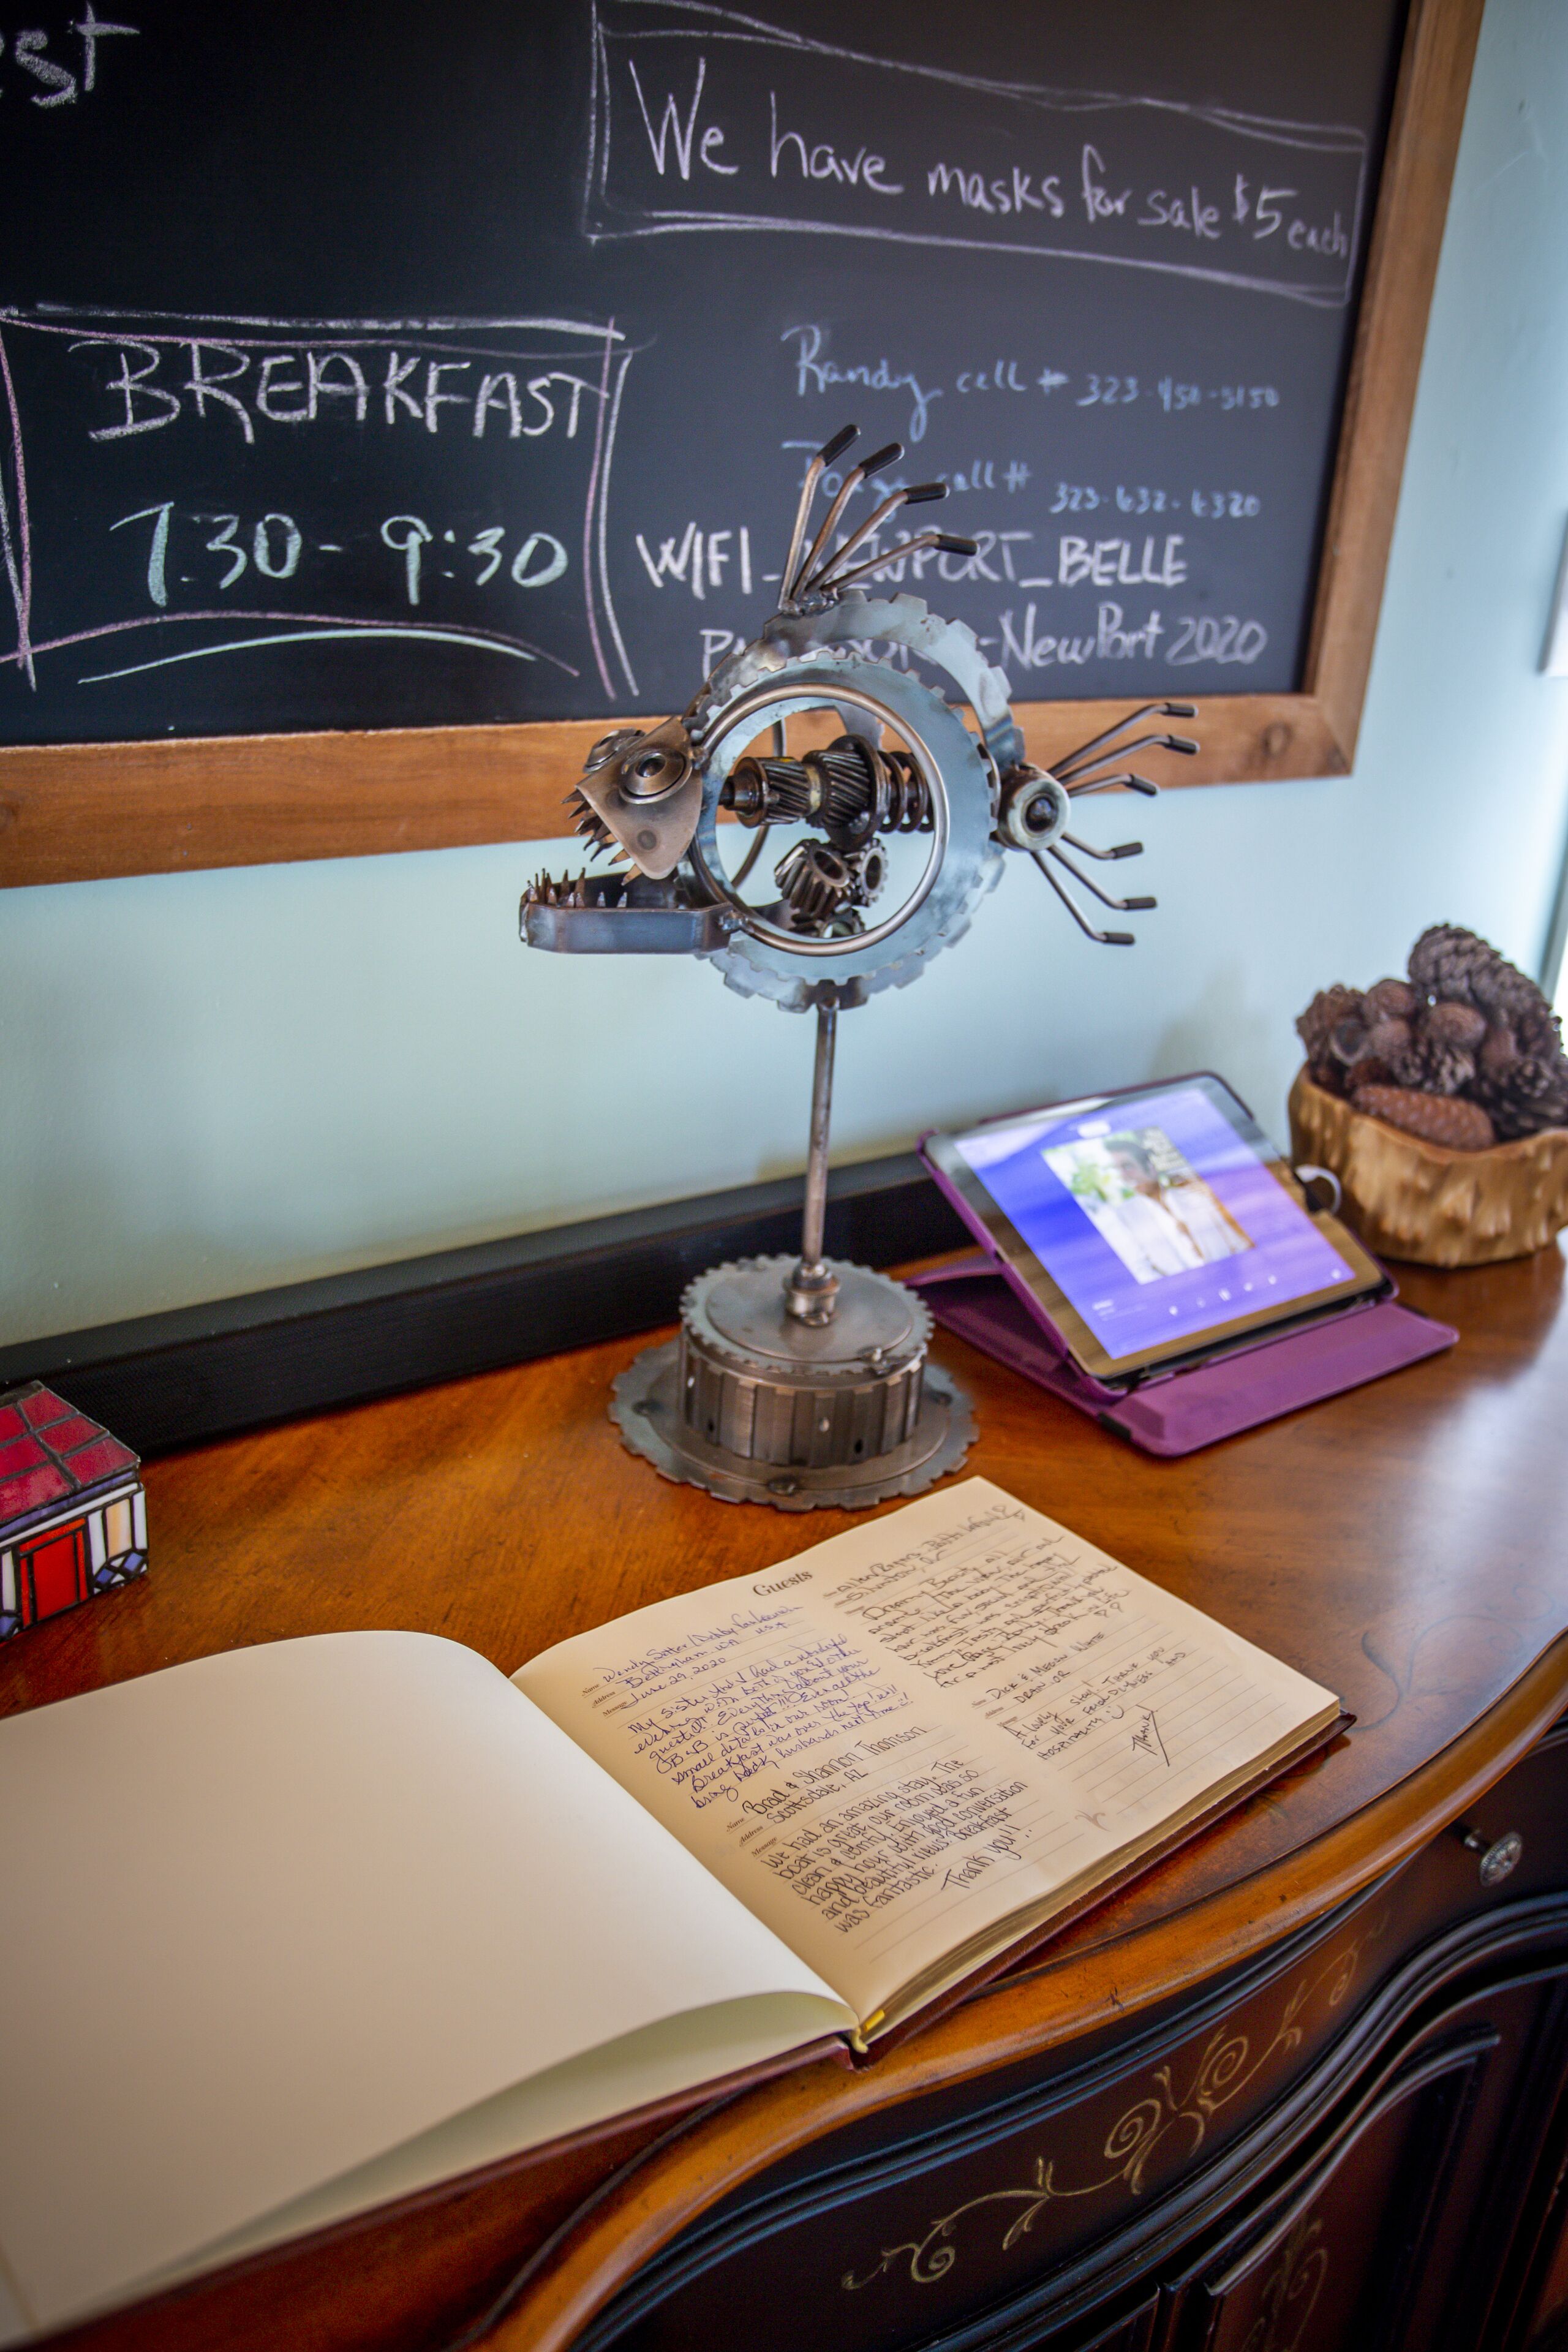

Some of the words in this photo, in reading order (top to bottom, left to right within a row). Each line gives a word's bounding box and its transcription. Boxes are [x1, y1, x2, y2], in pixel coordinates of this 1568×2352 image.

[628, 56, 738, 181] We
[771, 91, 905, 196] have
[927, 164, 1065, 219] masks
[1080, 143, 1136, 224] for
[1137, 185, 1221, 241] sale
[1287, 210, 1348, 259] each
[67, 339, 610, 445] BREAKFAST
[780, 324, 944, 443] Randy
[956, 357, 1028, 393] cell
[380, 514, 569, 606] 9:30
[635, 521, 753, 601] WIFI
[752, 1571, 813, 1596] Guests
[582, 1684, 600, 1694] Name
[617, 1684, 667, 1710] June
[692, 1657, 726, 1675] 2020
[794, 1667, 835, 1691] about
[836, 1659, 869, 1680] your
[593, 1691, 616, 1707] Address
[602, 1701, 627, 1717] Message
[627, 1718, 671, 1735] My
[748, 1659, 783, 1679] had
[704, 1696, 740, 1714] with
[741, 1678, 771, 1696] both
[715, 1732, 729, 1741] is
[766, 1726, 792, 1747] was
[794, 1721, 821, 1736] over
[821, 1707, 851, 1722] the
[1003, 1726, 1028, 1740] A
[671, 1752, 716, 1785] small
[720, 1726, 772, 1757] details
[766, 1722, 785, 1733] in
[784, 1709, 810, 1724] our
[775, 1728, 840, 1759] husbands
[741, 1789, 793, 1815] Brad
[792, 1752, 864, 1785] Shannon
[854, 1726, 929, 1756] Thomson
[843, 1769, 869, 1782] AZ
[944, 1799, 960, 1808] a
[951, 1787, 986, 1801] fun
[726, 1817, 745, 1831] Name
[760, 1851, 790, 1869] We
[782, 1828, 823, 1851] had
[819, 1819, 844, 1834] an
[838, 1792, 912, 1822] amazing
[897, 1776, 943, 1794] stay.
[930, 1760, 965, 1774] The
[772, 1853, 816, 1880] boat
[812, 1847, 832, 1858] is
[868, 1809, 896, 1825] our
[894, 1792, 935, 1812] room
[930, 1780, 963, 1796] was
[958, 1770, 980, 1782] so
[885, 1803, 949, 1833] Enjoyed
[740, 1825, 764, 1846] Address
[751, 1837, 777, 1857] Message
[801, 1873, 869, 1905] happy
[841, 1849, 889, 1874] hour
[887, 1830, 927, 1854] with
[921, 1815, 957, 1839] good
[952, 1781, 1028, 1822] conversation
[821, 1890, 860, 1920] and
[853, 1849, 917, 1896] beautiful
[945, 1807, 1012, 1841] Breakfast
[830, 1857, 845, 1866] &
[940, 1855, 995, 1891] Thank
[791, 1866, 833, 1896] clean
[834, 1909, 870, 1933] was
